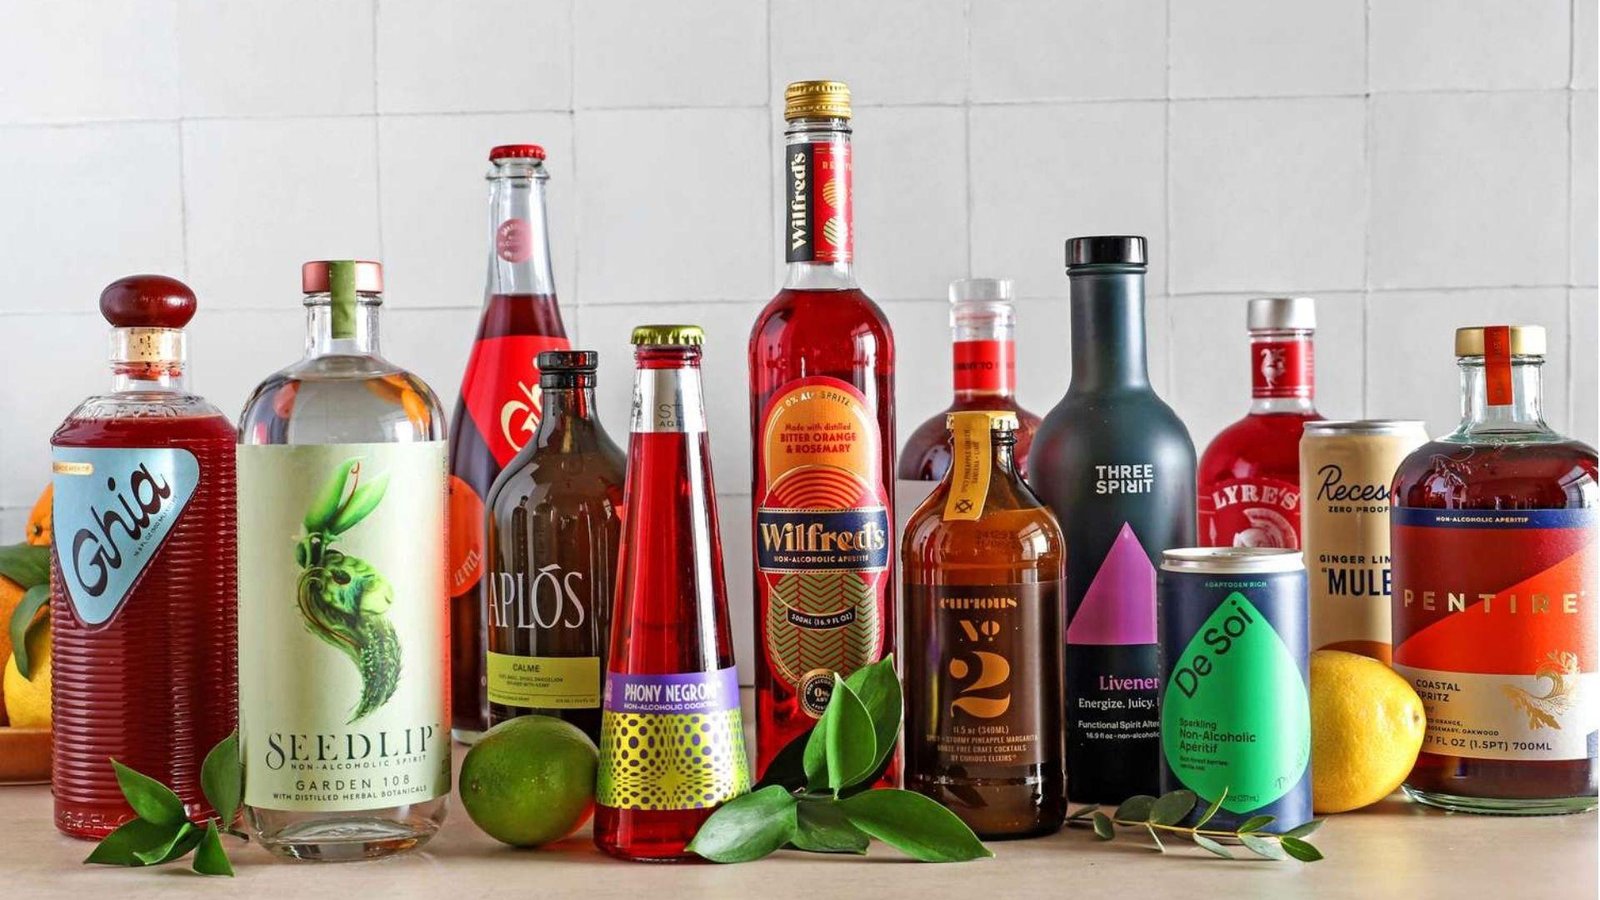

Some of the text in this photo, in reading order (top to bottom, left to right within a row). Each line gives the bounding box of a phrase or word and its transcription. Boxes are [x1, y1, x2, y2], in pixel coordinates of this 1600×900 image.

[821, 390, 850, 406] SPRITZ
[824, 422, 851, 431] distilled
[780, 432, 856, 442] BITTER ORANGE
[795, 444, 852, 454] ROSEMARY
[1095, 464, 1154, 479] THREE
[1096, 479, 1154, 494] SPIRIT
[1213, 484, 1300, 510] LYRE'S
[72, 462, 171, 597] Ghia
[760, 522, 886, 552] Wilfred's
[774, 555, 836, 563] NON-ALCOHOLIC
[1320, 555, 1391, 564] GINGER LI
[940, 597, 1018, 610] curious
[1404, 589, 1578, 614] PENTIRE
[1174, 600, 1254, 699] De Soi
[512, 663, 541, 673] CALME
[950, 651, 1011, 718] 2
[1100, 675, 1160, 690] Livener
[1416, 679, 1461, 691] COASTAL
[624, 683, 662, 702] PHONY
[624, 703, 682, 711] NON-ALCOHOLIC
[1078, 698, 1155, 711] Energize. Juicy.
[1077, 720, 1119, 729] Functional
[1120, 721, 1141, 730] Spirit
[1180, 718, 1217, 731] Sparkling
[1180, 728, 1256, 742] Non-Alcoholic
[266, 725, 434, 770] SEEDLIP
[994, 744, 1027, 753] COCKTAILS
[1436, 736, 1447, 746] FL
[1451, 738, 1466, 747] OZ
[1470, 740, 1508, 751] (1.5PT)
[1512, 742, 1552, 751] 700ML
[291, 755, 428, 770] NON-ALCOHOLIC SPIRIT
[296, 774, 411, 791] GARDEN 108
[273, 785, 428, 801] WITH DISTILLED HERBAL BOTANICALS
